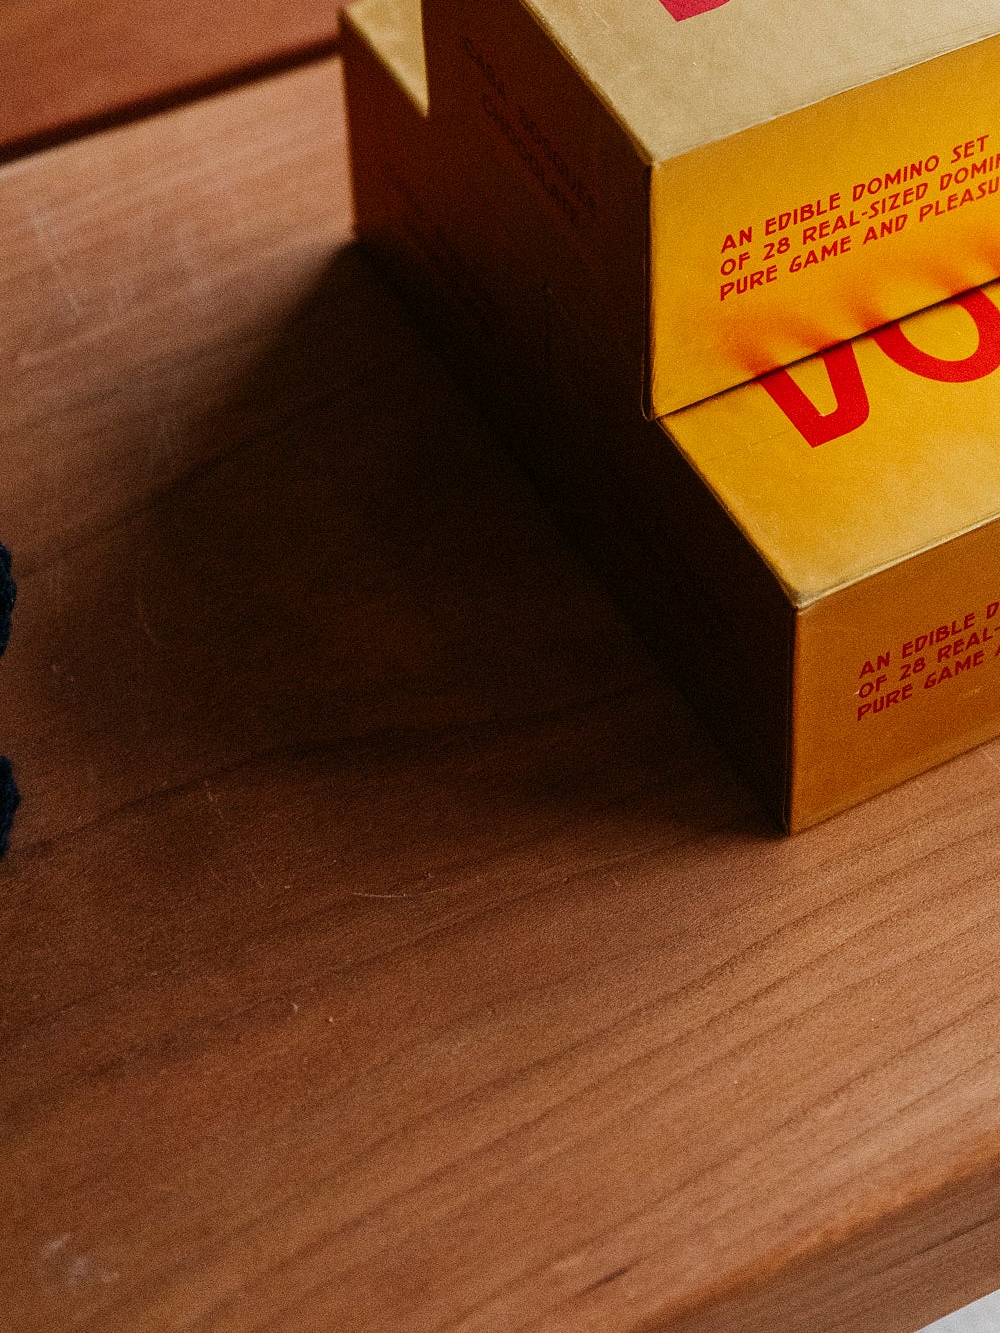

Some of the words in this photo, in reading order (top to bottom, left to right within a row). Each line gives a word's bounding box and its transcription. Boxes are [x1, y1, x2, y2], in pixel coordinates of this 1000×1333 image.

[720, 252, 750, 277] OF
[762, 237, 791, 262] 28
[803, 182, 929, 246] REAL-SIZED
[721, 226, 752, 253] AN
[765, 193, 841, 237] EDIBLE
[852, 155, 940, 203] DOMINO
[950, 134, 989, 164] SET
[720, 266, 778, 301] PURE
[789, 235, 852, 274] GAME
[862, 214, 909, 246] AND
[856, 684, 913, 721] PURE
[924, 649, 985, 691] GAME
[857, 676, 887, 699] OF
[898, 657, 927, 682] 28
[858, 651, 891, 678] AN
[901, 613, 975, 657] EDIBLE
